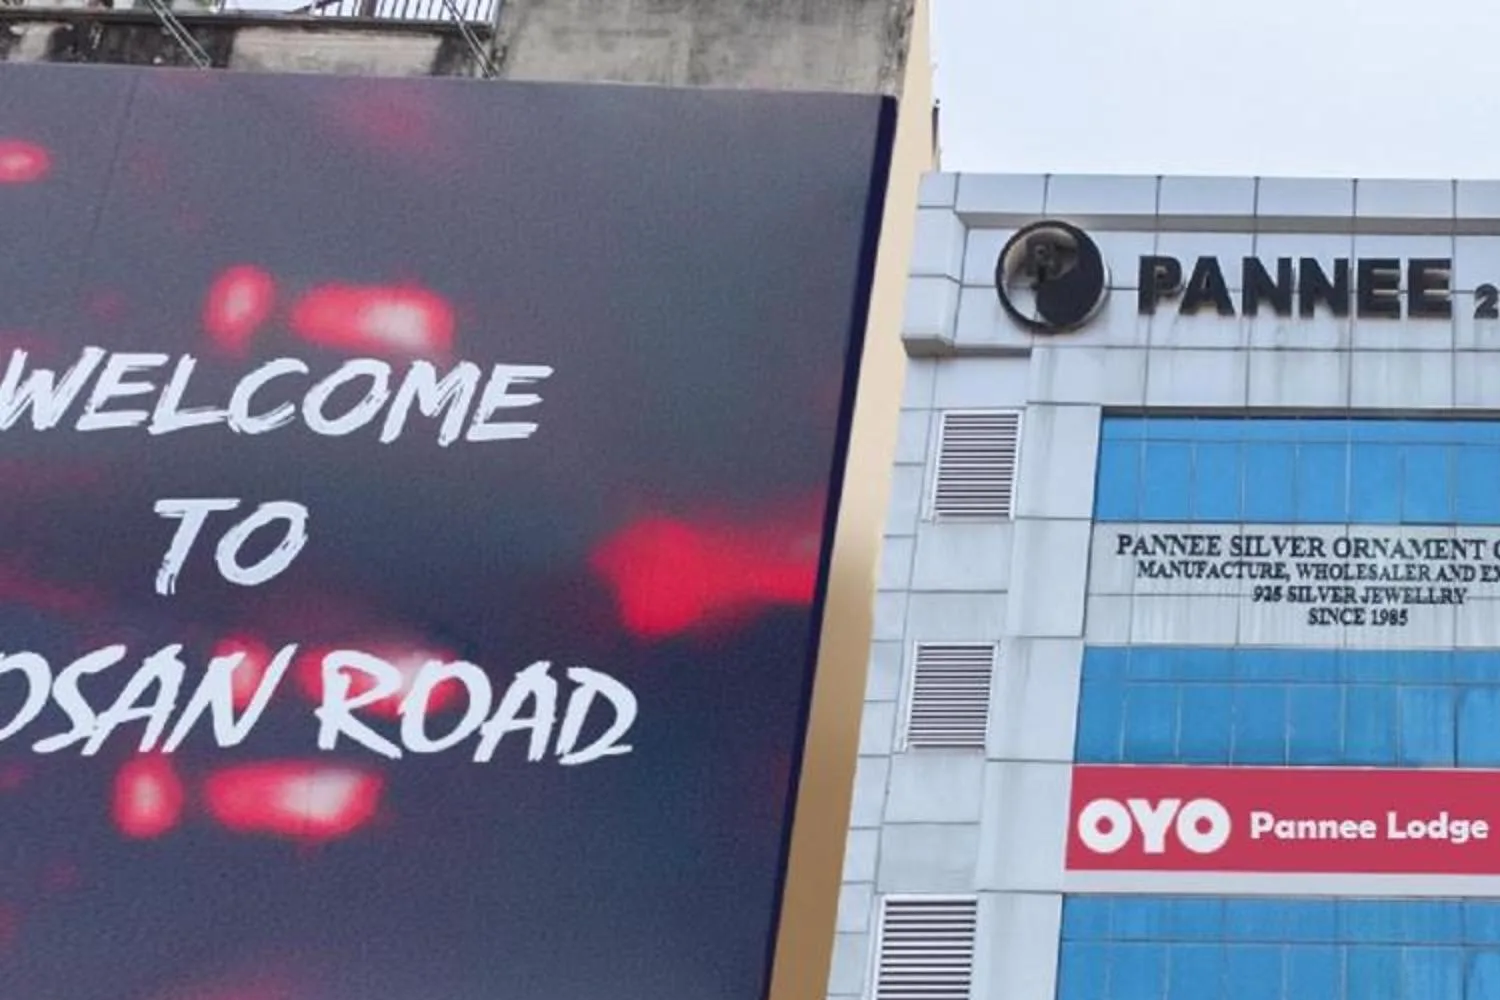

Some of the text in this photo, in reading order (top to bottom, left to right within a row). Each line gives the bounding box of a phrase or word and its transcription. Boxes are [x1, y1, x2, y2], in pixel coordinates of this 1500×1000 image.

[1138, 255, 1453, 319] PANNEE
[0, 346, 553, 446] WELCOME
[154, 498, 309, 595] TO
[1117, 534, 1221, 557] PANNEE
[1230, 535, 1326, 558] SILVER
[1333, 537, 1486, 561] ORNAMENT
[1137, 560, 1291, 582] MANUFACTURE,
[1297, 563, 1431, 582] WHOLESALER
[1437, 564, 1476, 582] AND
[1253, 585, 1467, 605] 925 SILVER JEWELLRY
[1308, 607, 1408, 627] SINCE 1985
[315, 650, 639, 766] ROAD
[1077, 798, 1489, 854] OYO Pannee Lodge
